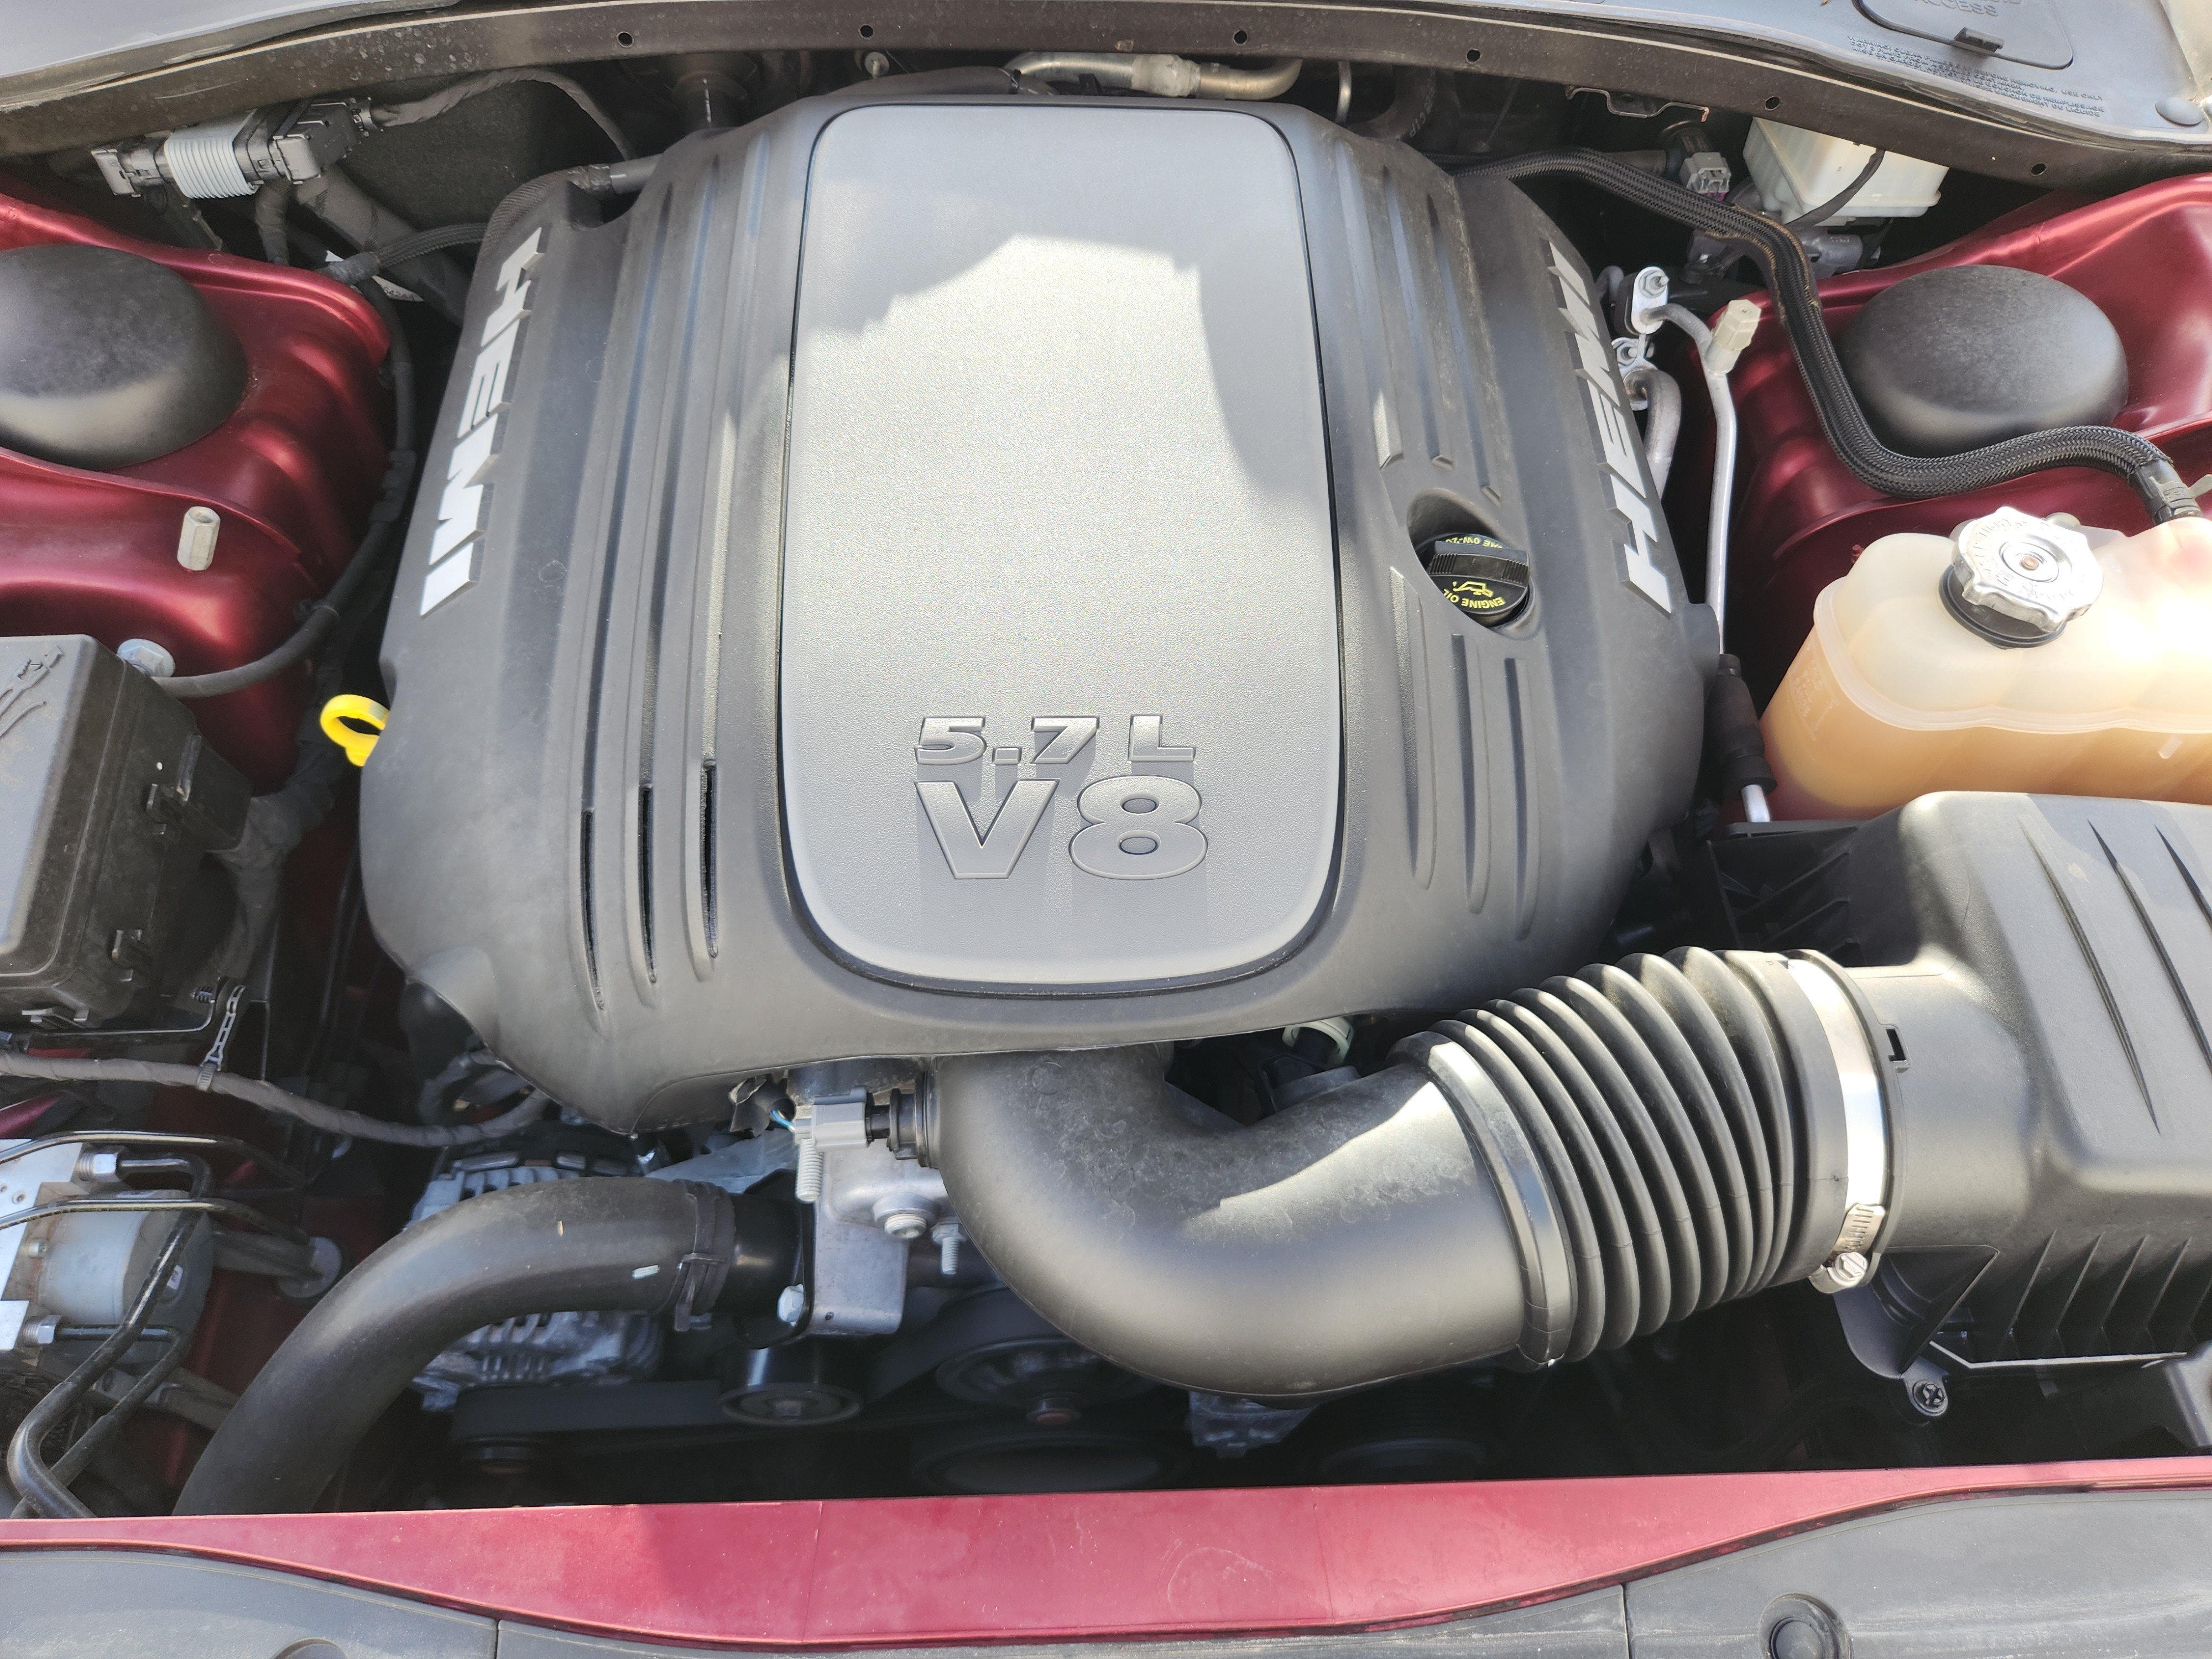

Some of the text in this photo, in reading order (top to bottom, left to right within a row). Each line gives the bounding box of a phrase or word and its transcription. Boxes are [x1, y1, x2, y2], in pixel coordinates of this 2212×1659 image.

[1914, 0, 1999, 17] CESS
[419, 227, 543, 617] HEMI
[1549, 242, 1672, 614] HEMI
[1443, 588, 1506, 609] ENGINE OIL
[914, 774, 1208, 880] V8
